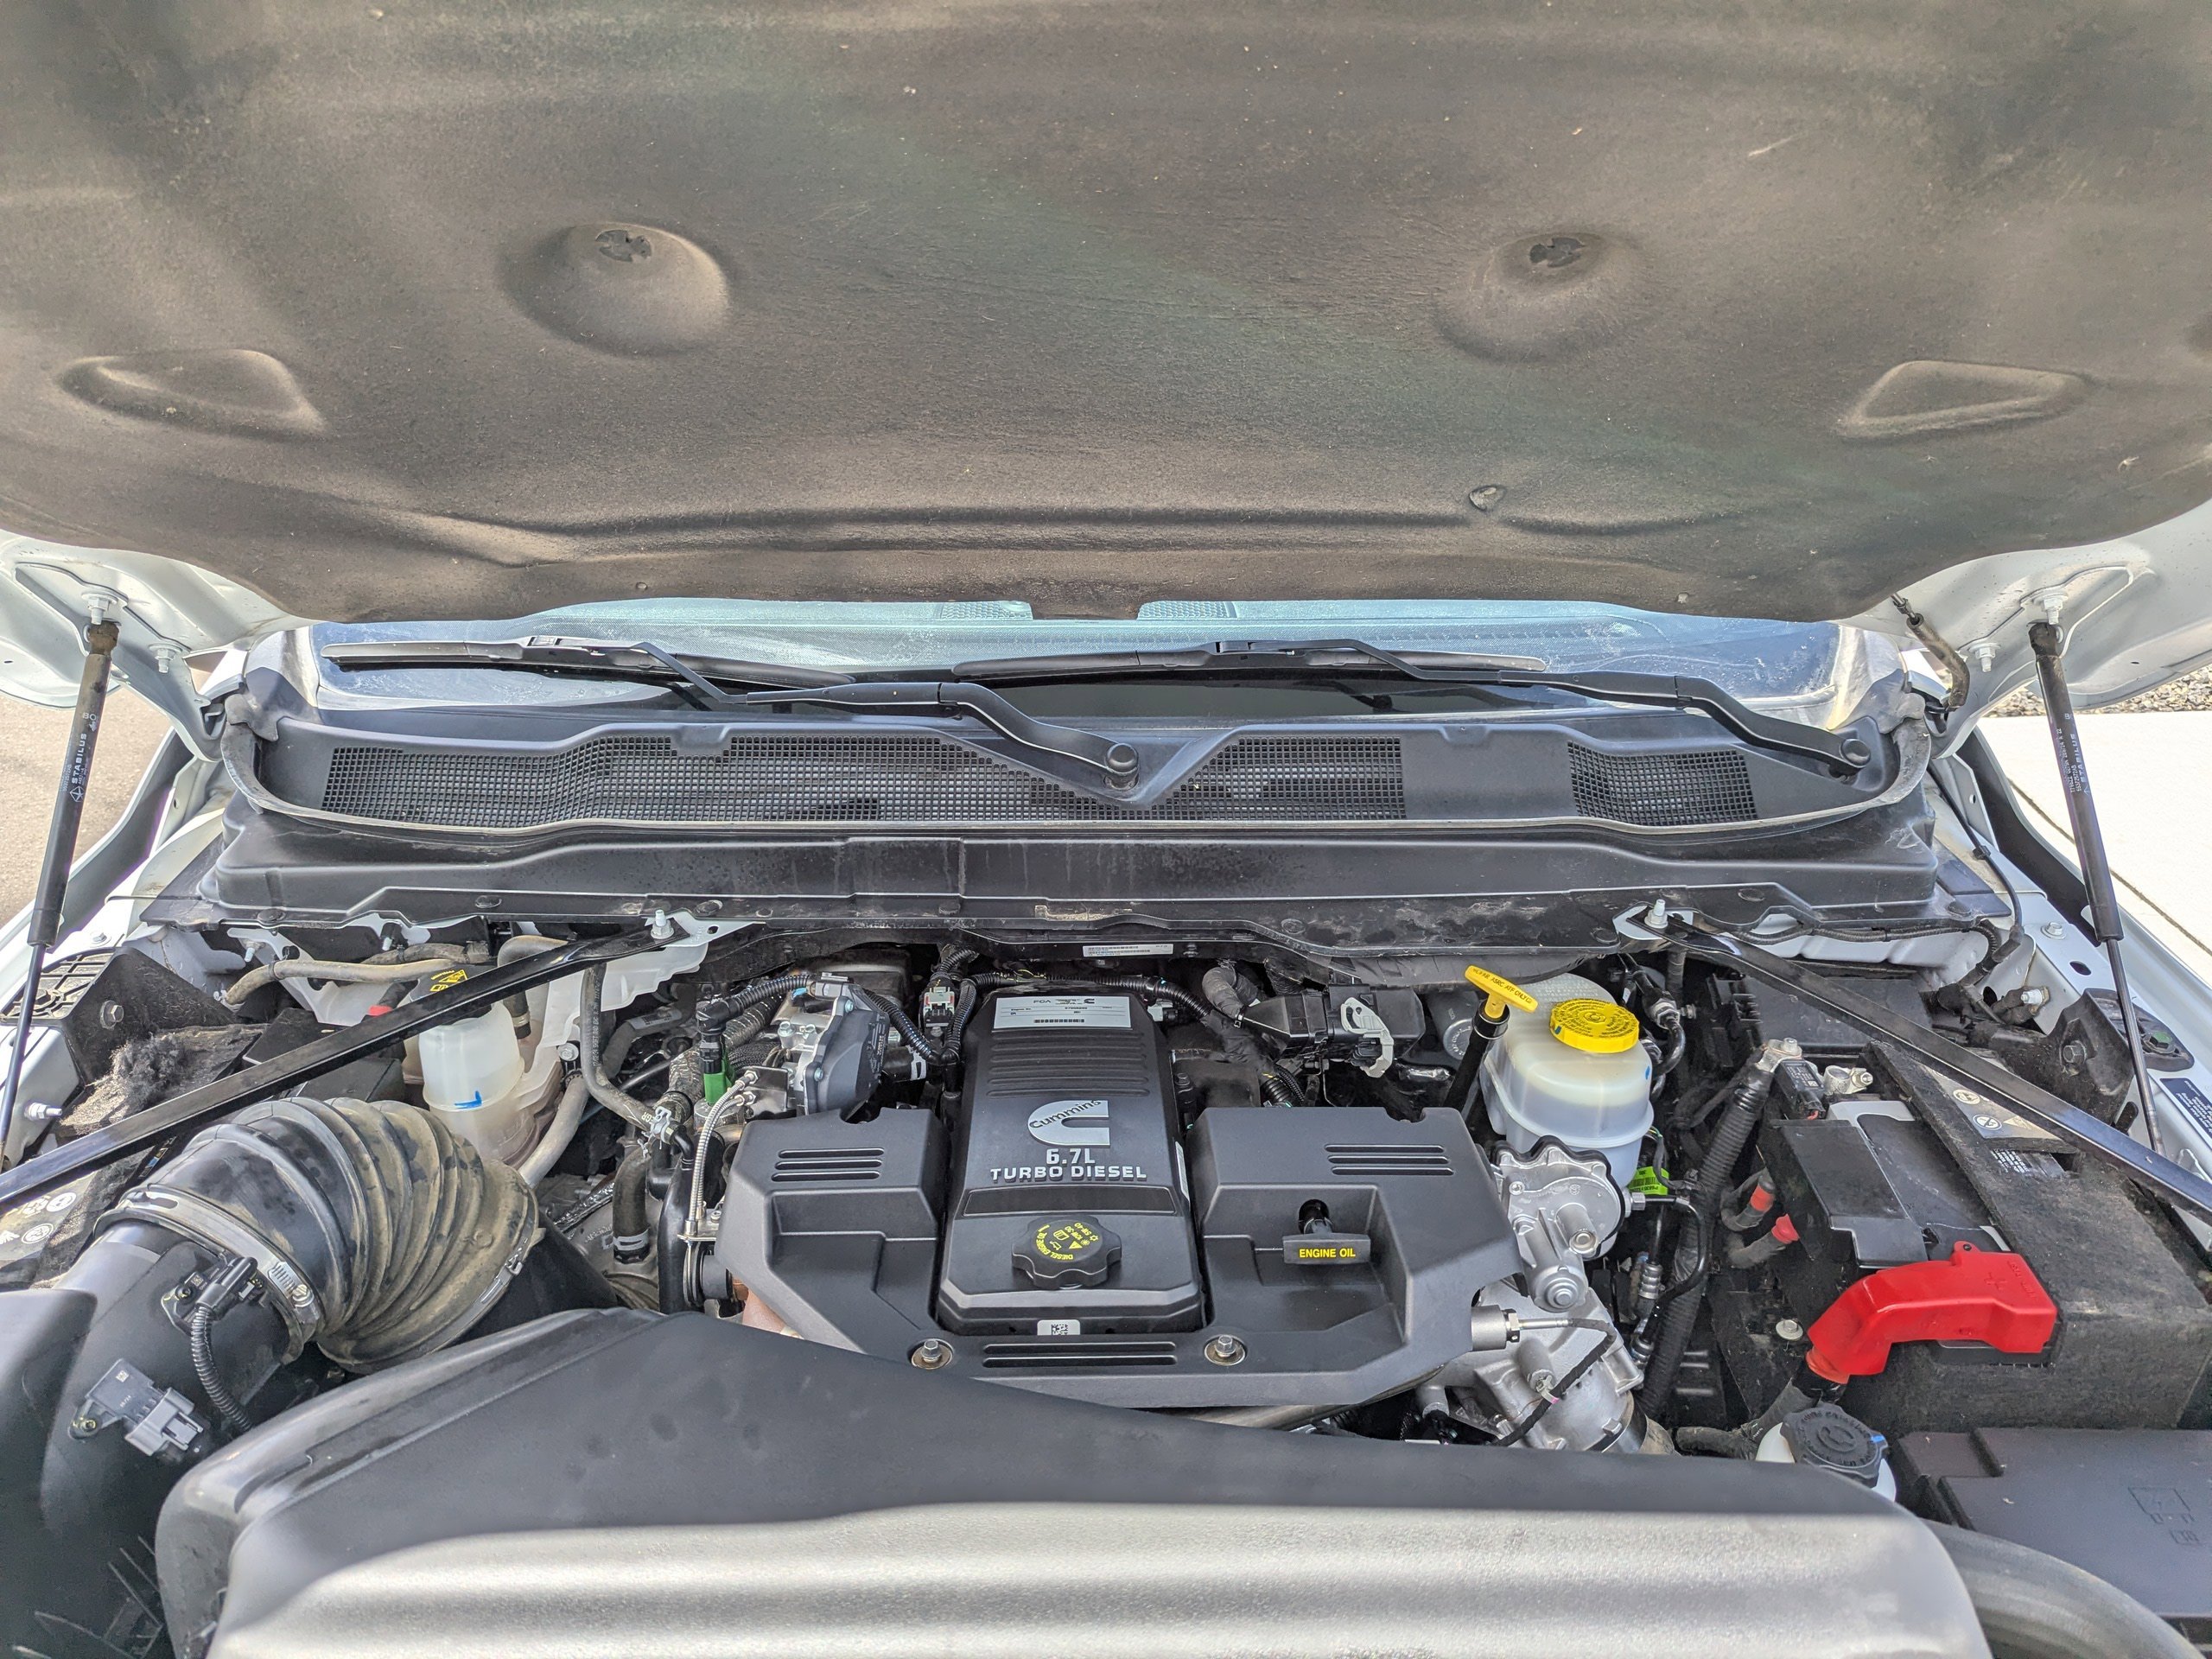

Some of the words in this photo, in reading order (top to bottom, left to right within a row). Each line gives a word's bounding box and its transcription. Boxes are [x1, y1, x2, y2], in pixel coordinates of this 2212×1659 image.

[72, 733, 87, 785] STABILUS
[2070, 734, 2088, 783] STABILUS
[1029, 1100, 1101, 1128] Cummins
[1046, 1148, 1096, 1164] 6.7L
[990, 1166, 1063, 1180] TURBO
[1071, 1166, 1147, 1179] DIESEL
[1050, 1251, 1074, 1261] DIESEL
[1299, 1249, 1337, 1258] ENGINE
[1339, 1248, 1356, 1257] OIL
